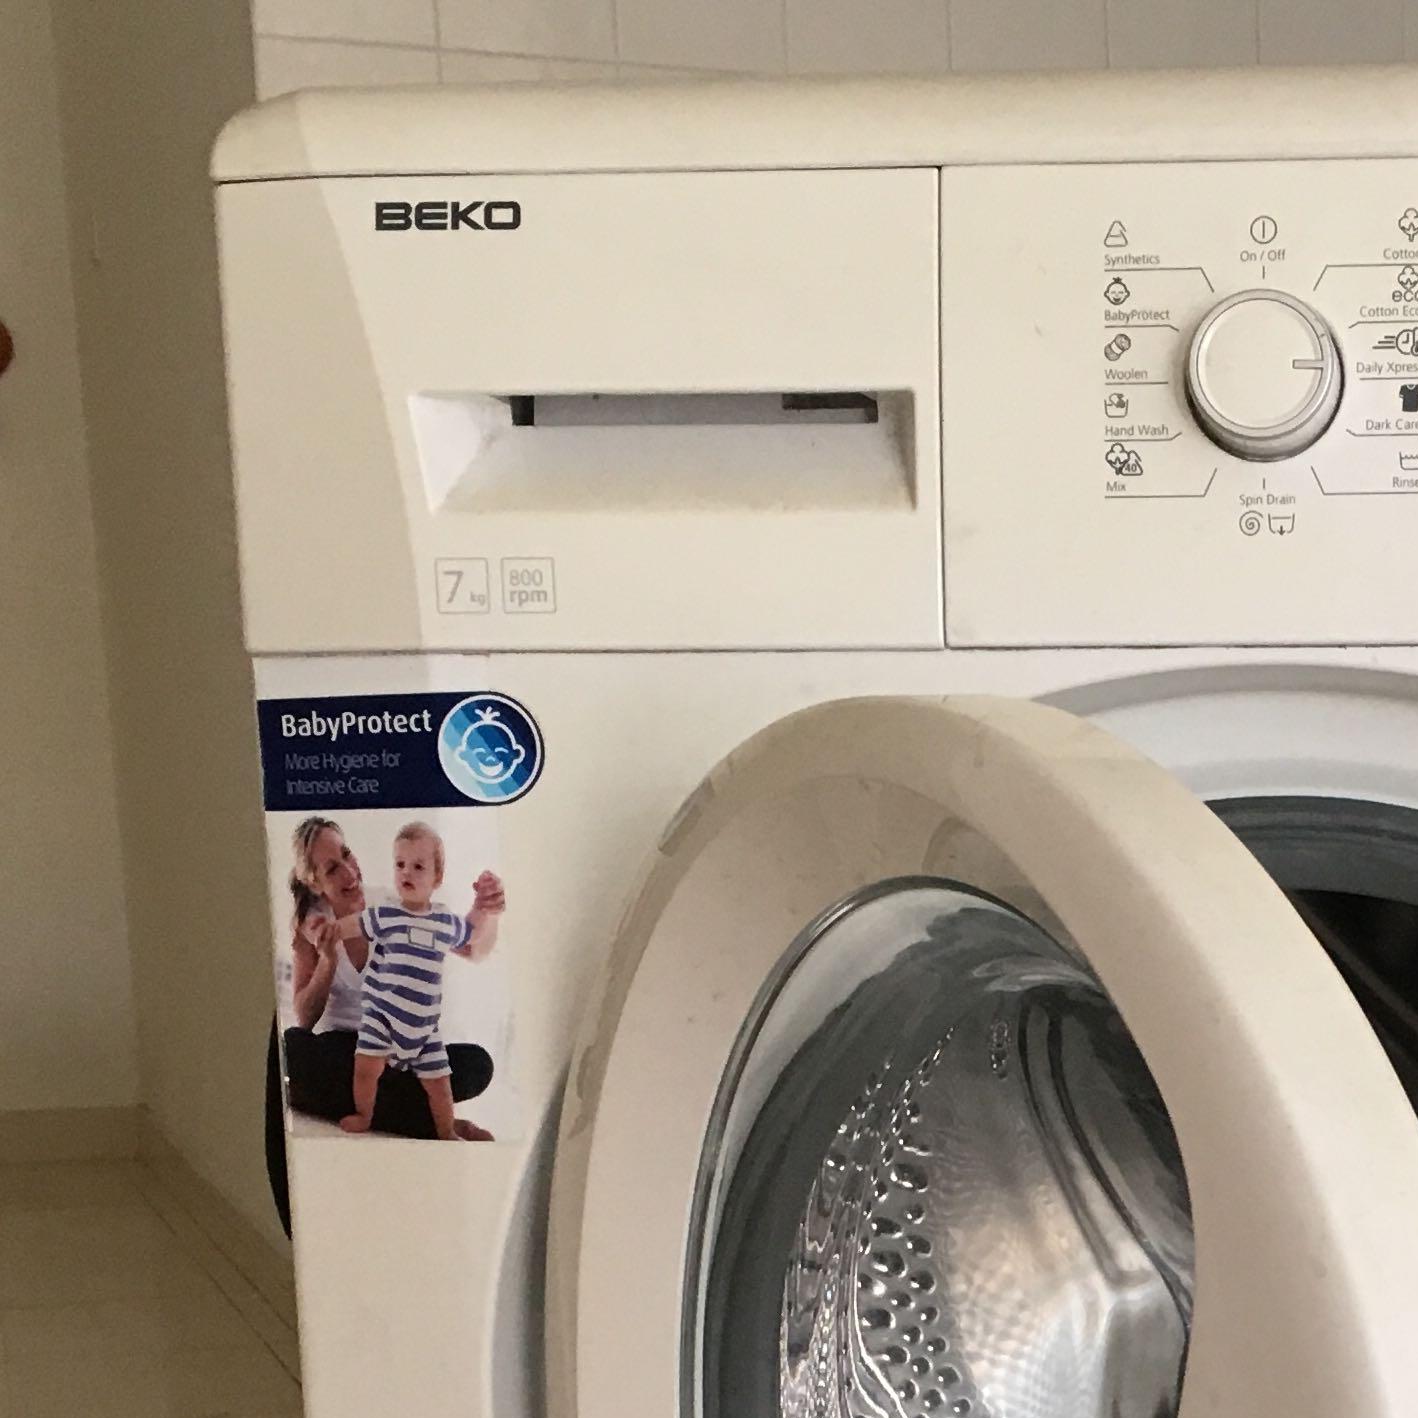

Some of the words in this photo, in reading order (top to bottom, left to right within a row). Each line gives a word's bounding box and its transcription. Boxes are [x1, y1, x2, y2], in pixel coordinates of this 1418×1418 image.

[375, 201, 521, 231] BEKO
[1104, 253, 1160, 266] Synthetics
[1240, 251, 1257, 262] On
[1267, 250, 1286, 261] Off
[1104, 309, 1170, 323] BabyProtect
[1360, 306, 1400, 318] Cotton
[1105, 368, 1148, 380] Woolen
[1356, 362, 1383, 375] Daily
[1105, 425, 1135, 437] Hand
[1137, 425, 1169, 436] Wash
[1366, 419, 1393, 431] Dark
[1106, 481, 1127, 492] Mix
[1239, 494, 1263, 507] Spin
[1266, 494, 1296, 505] Drain
[509, 569, 543, 586] 800
[443, 570, 464, 604] 7
[470, 590, 486, 606] kg
[509, 589, 548, 605] rpm
[281, 709, 433, 742] BabyProtect
[285, 752, 320, 770] More
[348, 776, 380, 794] Care
